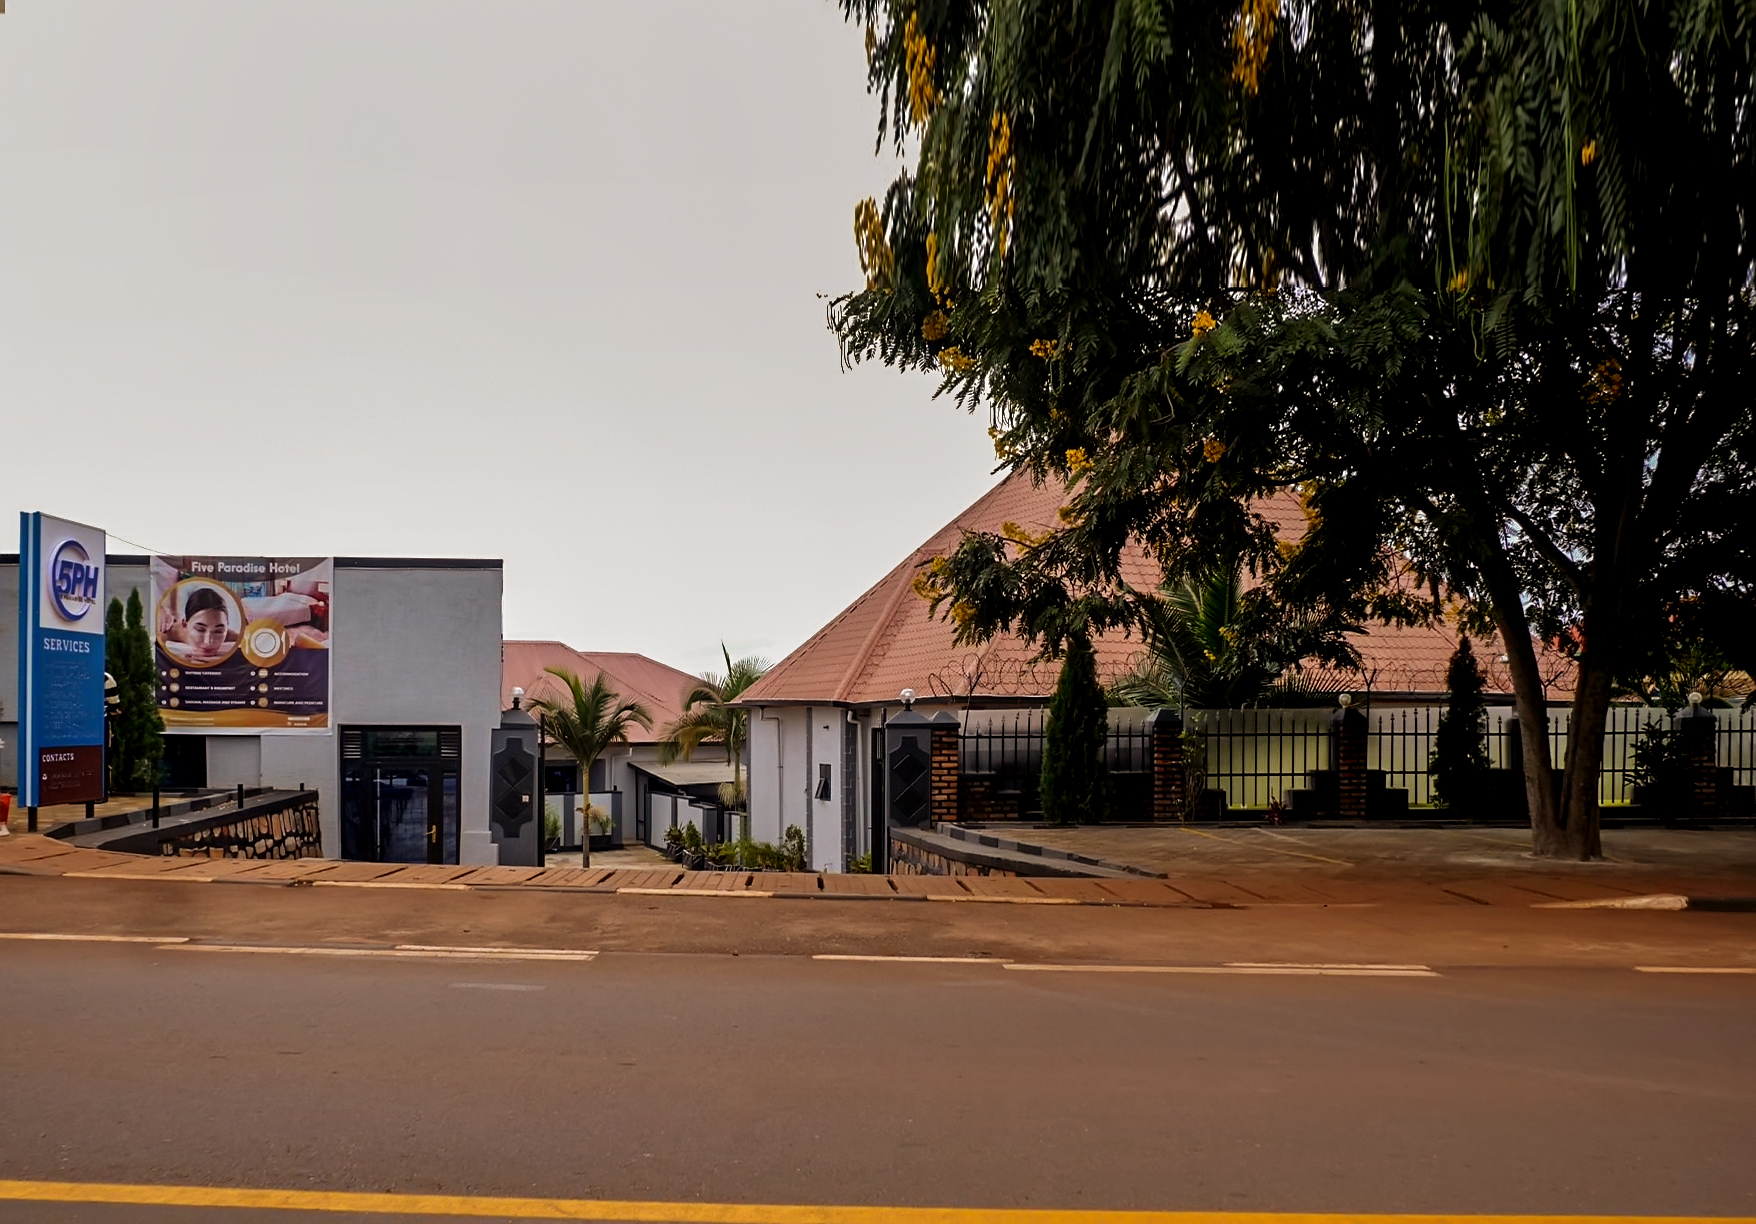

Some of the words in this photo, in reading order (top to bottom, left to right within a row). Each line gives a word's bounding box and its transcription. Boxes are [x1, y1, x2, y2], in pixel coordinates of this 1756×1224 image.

[191, 561, 214, 573] Five
[217, 561, 266, 574] Paradise
[269, 562, 300, 574] Hotel
[57, 559, 99, 599] 5PH
[43, 637, 90, 654] SERVICES
[42, 752, 75, 763] CONTACTS
